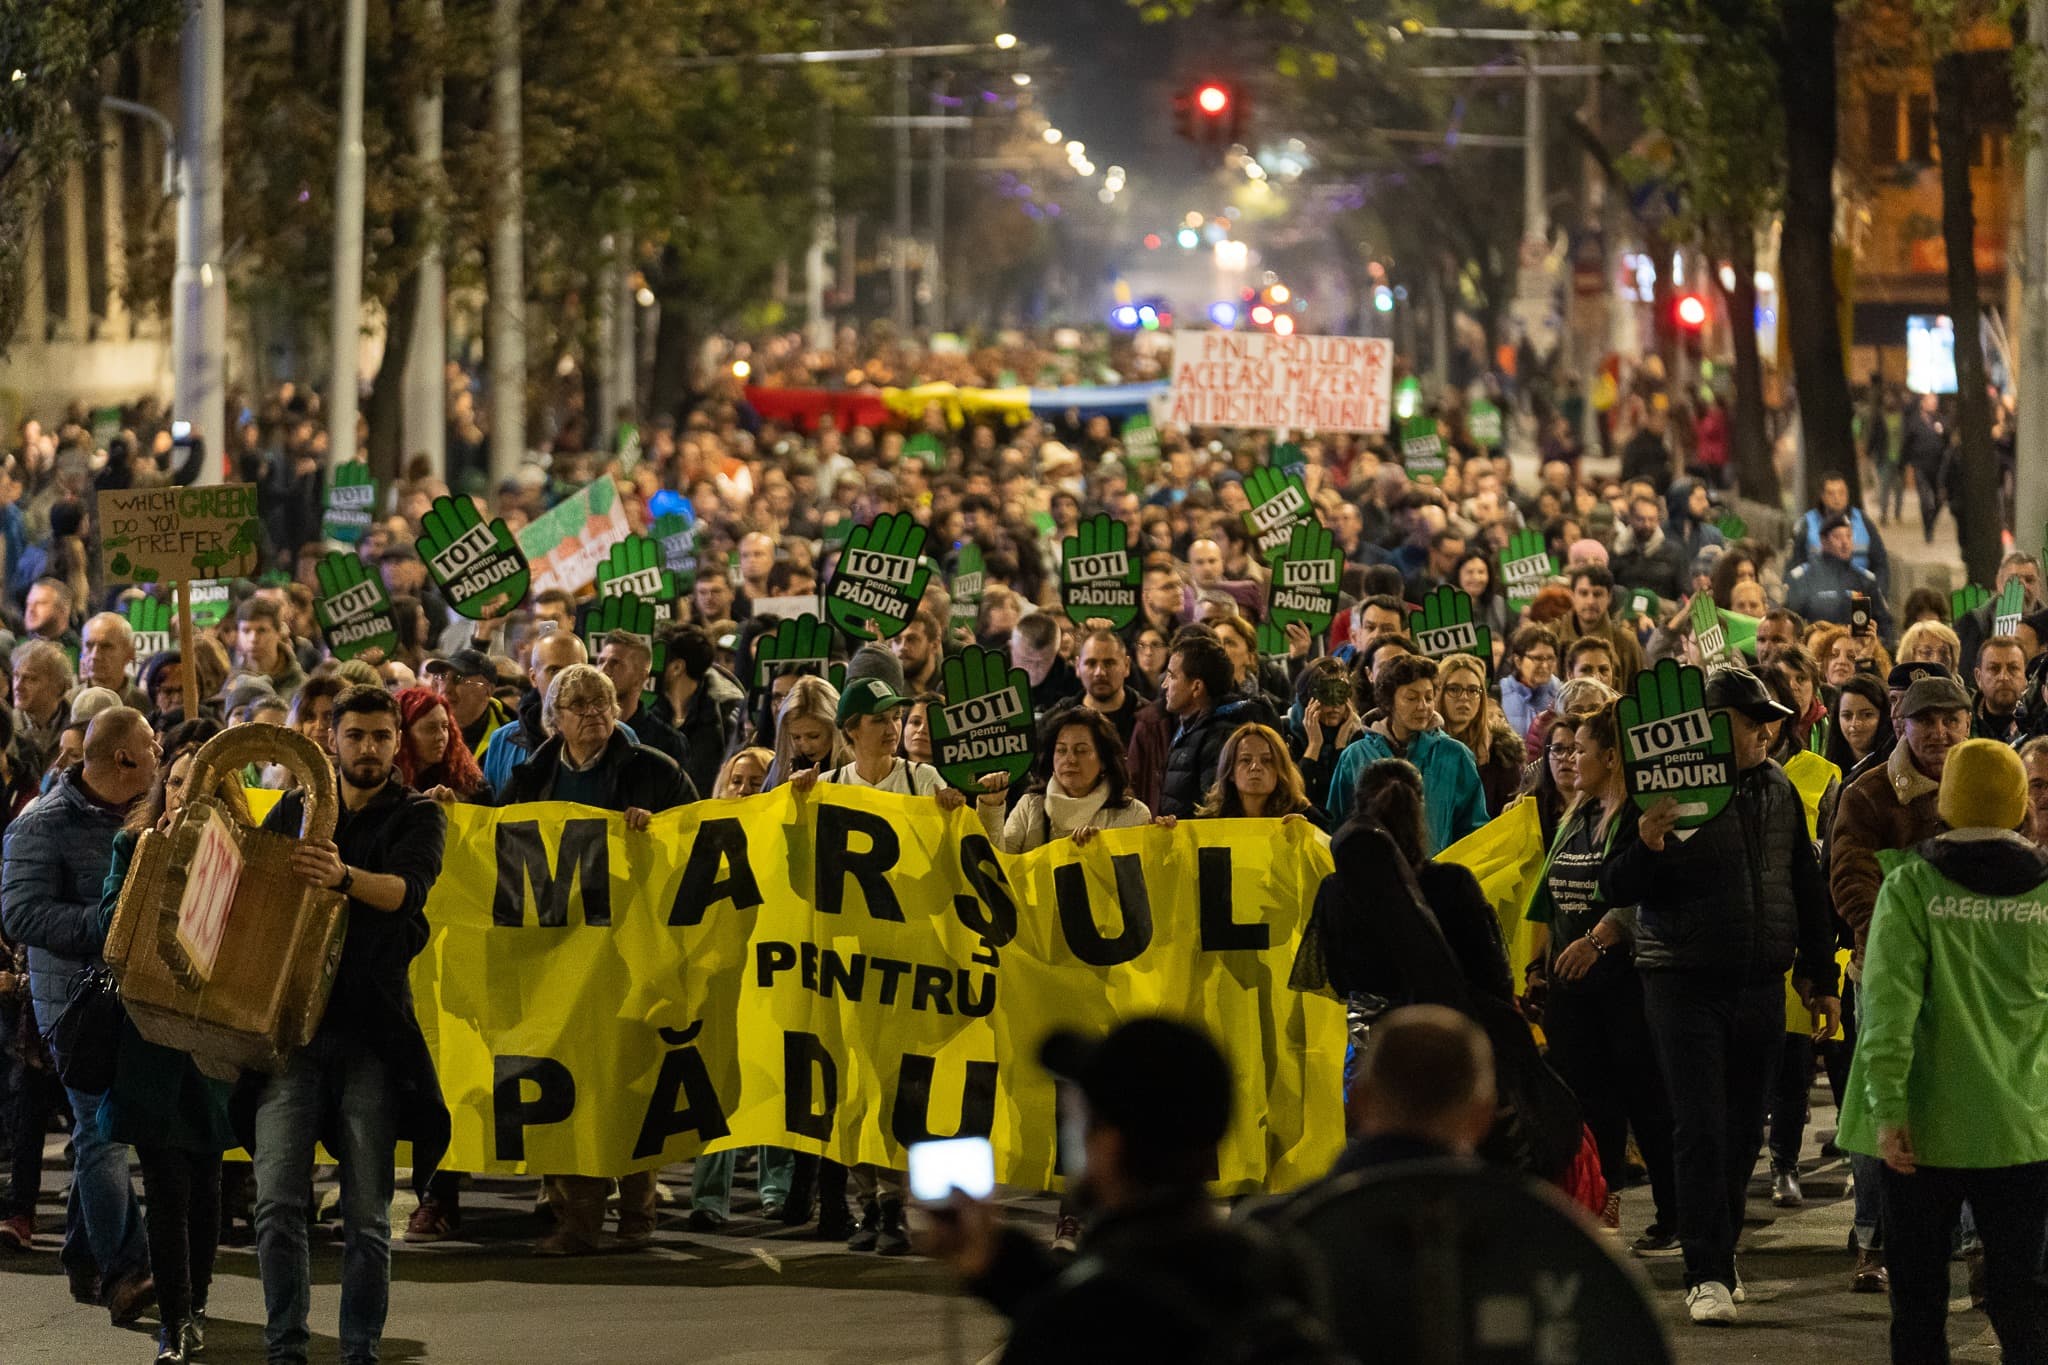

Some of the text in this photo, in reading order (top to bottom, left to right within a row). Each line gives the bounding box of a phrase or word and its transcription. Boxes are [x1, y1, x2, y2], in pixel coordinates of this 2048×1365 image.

[112, 488, 257, 518] WHICH GREEN
[113, 513, 180, 534] DO YOU
[451, 555, 521, 603] PĂDURI
[466, 553, 498, 576] pentru
[852, 551, 909, 580] TOȚI
[835, 580, 909, 619] PĂDURI
[865, 579, 898, 595] pentru
[1069, 586, 1135, 605] PĂDURI
[1274, 590, 1331, 614] PĂDURI
[946, 691, 1015, 730] TOȚI
[969, 724, 1007, 740] pentru
[1630, 714, 1705, 754] TOȚI
[943, 734, 1028, 764] PĂDURI
[1664, 751, 1704, 766] pentru
[1636, 762, 1727, 792] PĂDURI
[494, 804, 1270, 968] MARȘUL
[757, 941, 998, 1018] PENTRU
